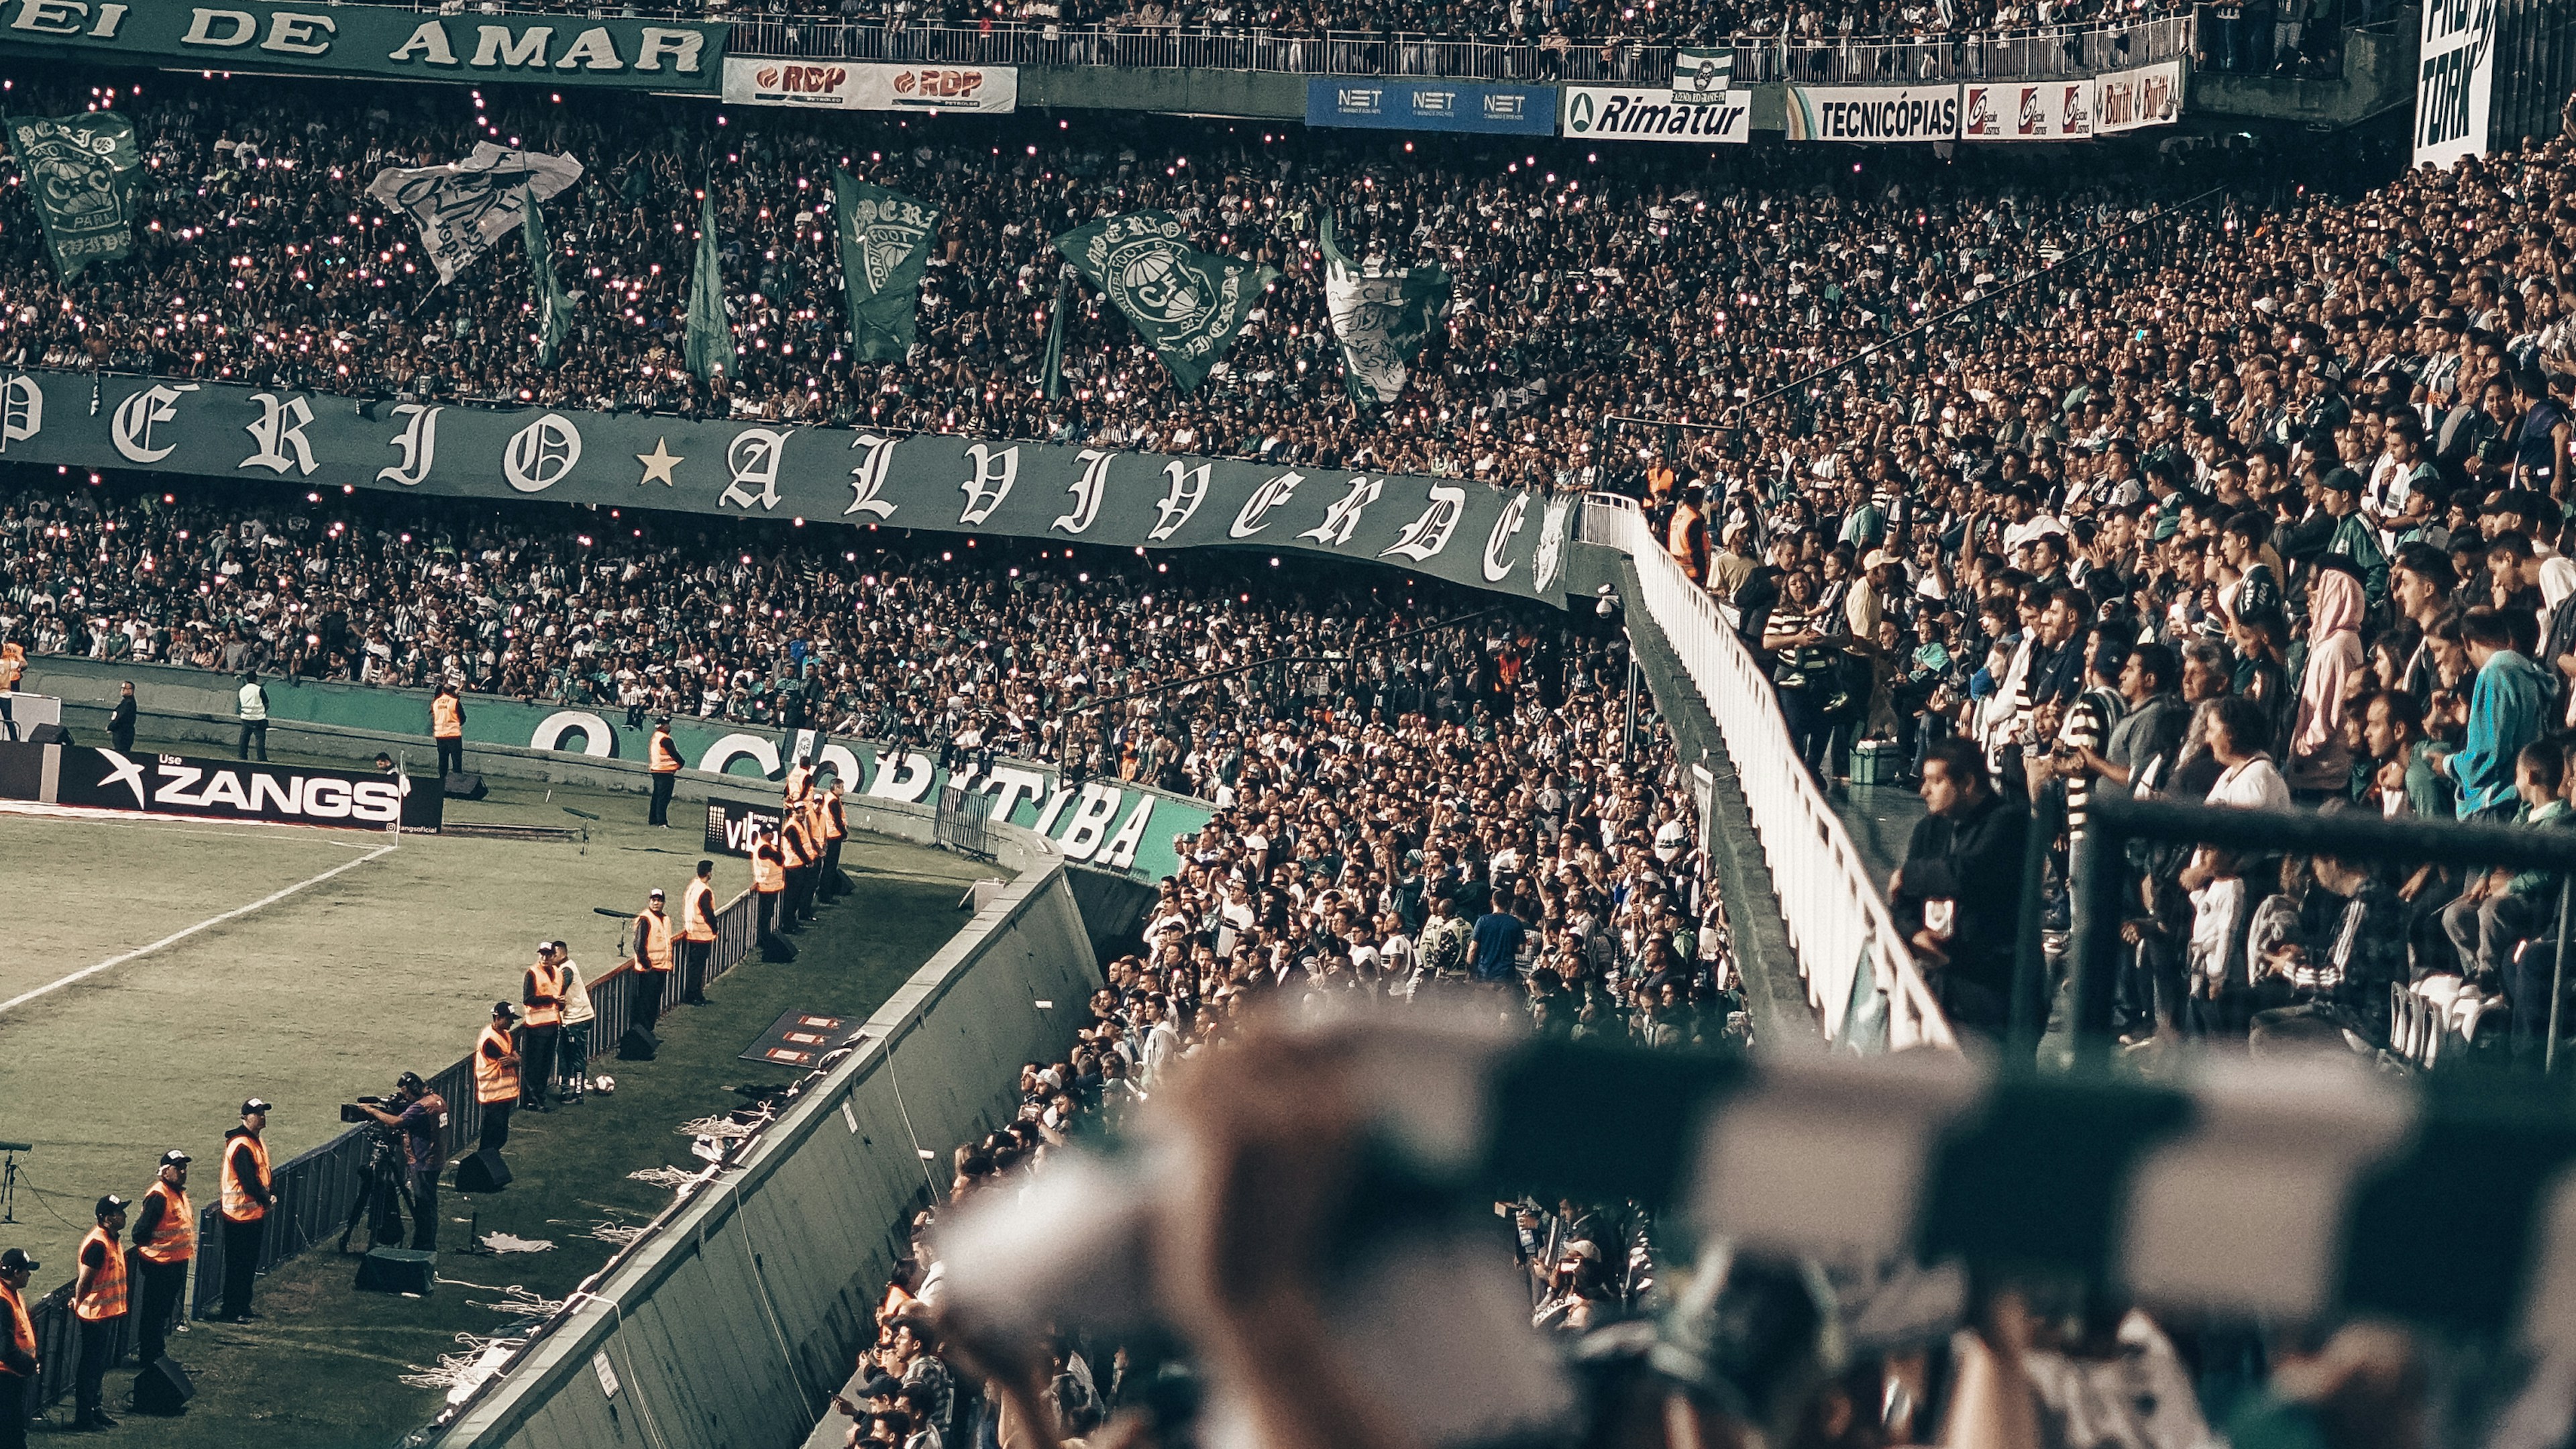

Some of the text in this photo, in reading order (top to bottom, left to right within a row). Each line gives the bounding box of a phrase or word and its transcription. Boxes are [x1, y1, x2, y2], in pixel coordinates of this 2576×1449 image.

[0, 0, 704, 72] EI DE AMAR
[782, 66, 846, 93] RDP
[919, 70, 983, 97] RDP
[1338, 89, 1383, 107] NET
[1413, 92, 1456, 109] NET
[1484, 95, 1525, 113] NET
[1596, 95, 1745, 136] Rimatur
[1822, 91, 1955, 138] TECNICÓPIAS
[718, 429, 1532, 582] ALVIVERDE
[158, 754, 182, 765] Use
[154, 765, 400, 822] ZANGS
[398, 825, 437, 833] angsoficial
